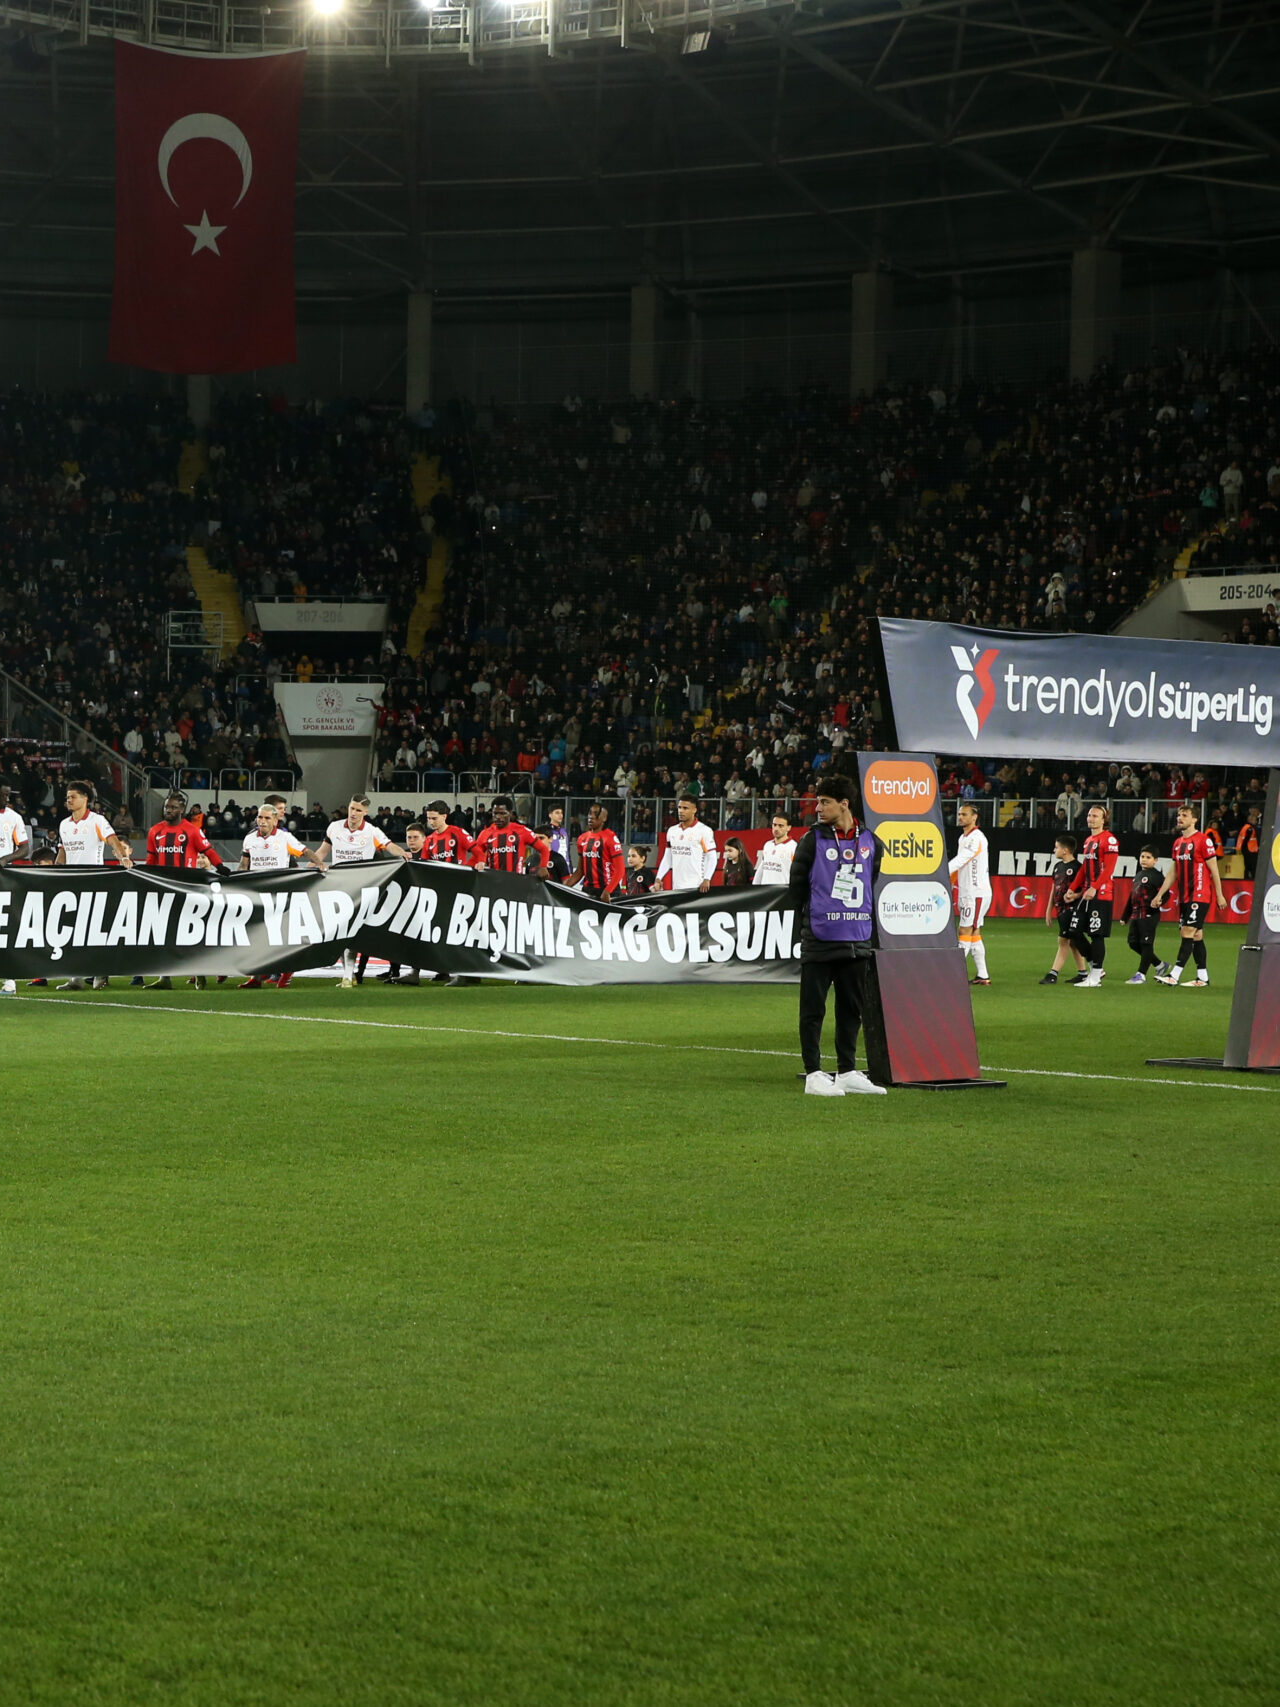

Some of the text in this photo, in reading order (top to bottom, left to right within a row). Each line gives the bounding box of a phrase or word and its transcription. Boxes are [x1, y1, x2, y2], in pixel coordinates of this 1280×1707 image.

[1219, 585, 1272, 600] 205-204
[1004, 663, 1157, 728] trendyol
[871, 774, 930, 799] trendyol
[882, 901, 933, 912] Türk Telekom
[960, 906, 971, 918] 10
[826, 912, 841, 921] TOP
[1189, 910, 1197, 920] 4
[14, 890, 176, 961] AÇILAN
[175, 881, 254, 947] BİR
[446, 892, 575, 963] BAŞIMIZ
[578, 905, 651, 963] SAĞ
[1089, 917, 1101, 929] 23
